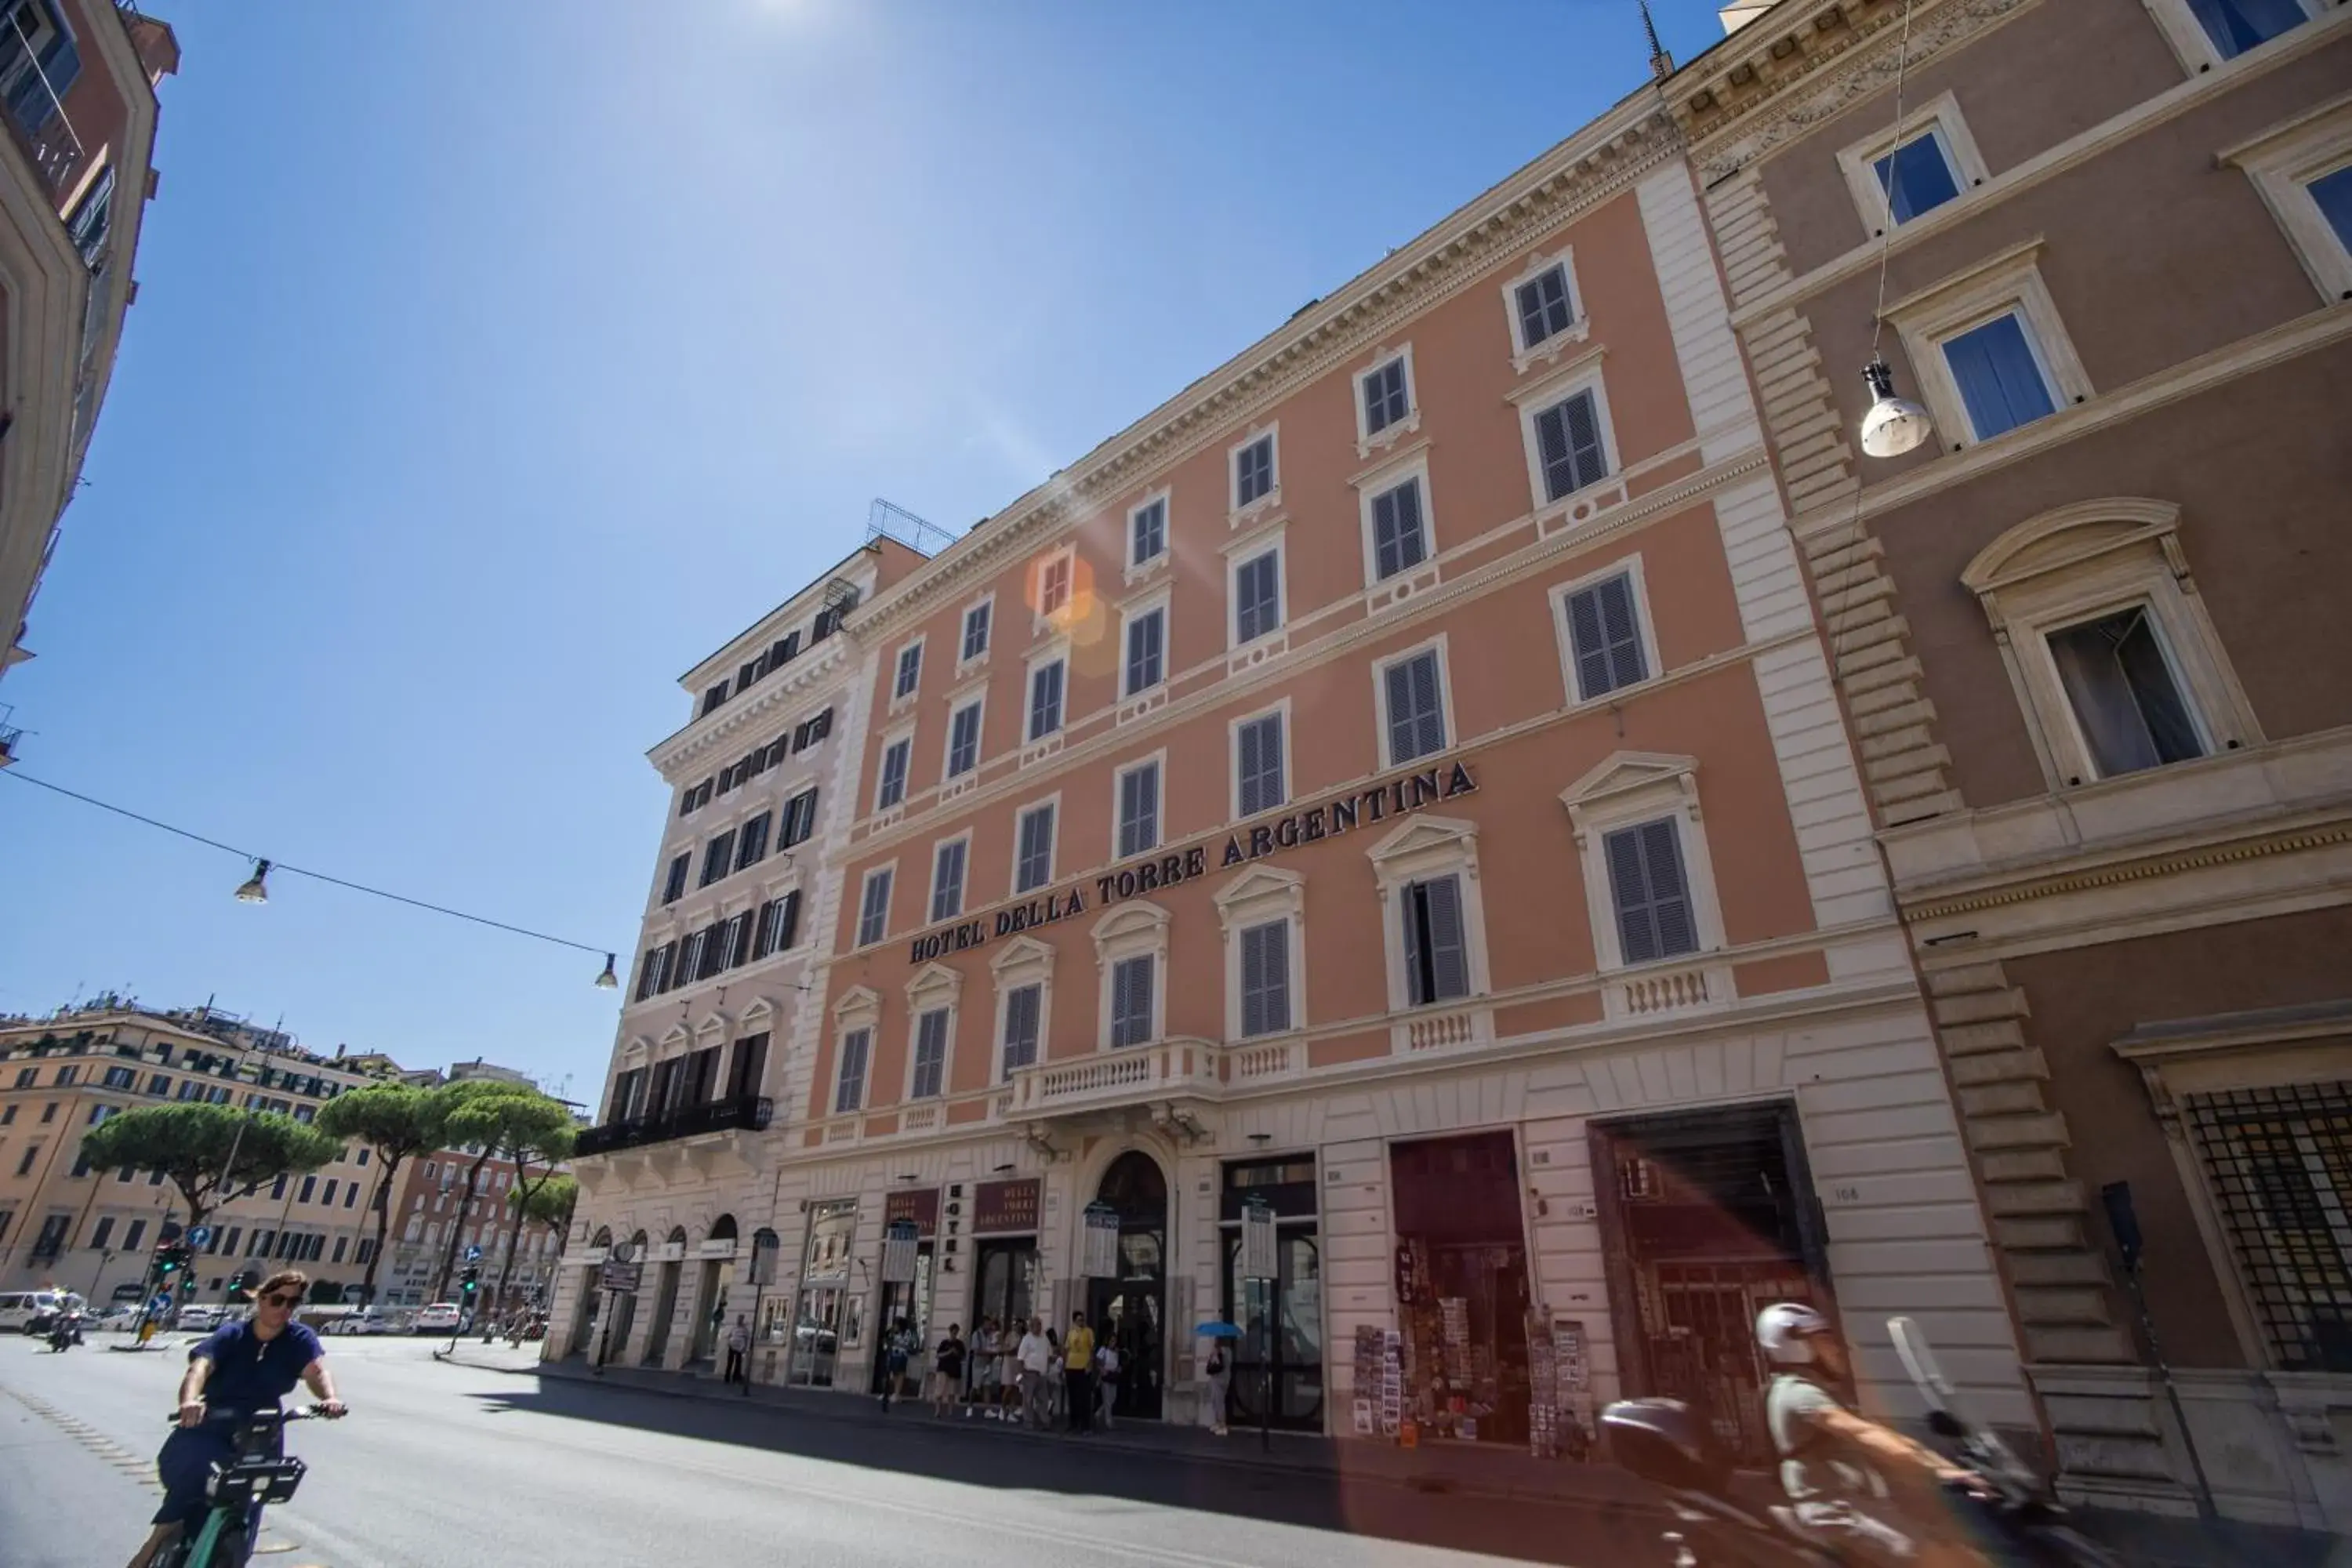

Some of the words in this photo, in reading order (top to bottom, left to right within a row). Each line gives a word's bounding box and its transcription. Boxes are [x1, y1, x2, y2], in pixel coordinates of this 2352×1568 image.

[909, 920, 986, 964] HOTEL
[995, 887, 1089, 938] DELLA
[1096, 846, 1207, 905] TORRE
[1220, 759, 1479, 869] ARGENTINA
[944, 1184, 962, 1272] HOTEL
